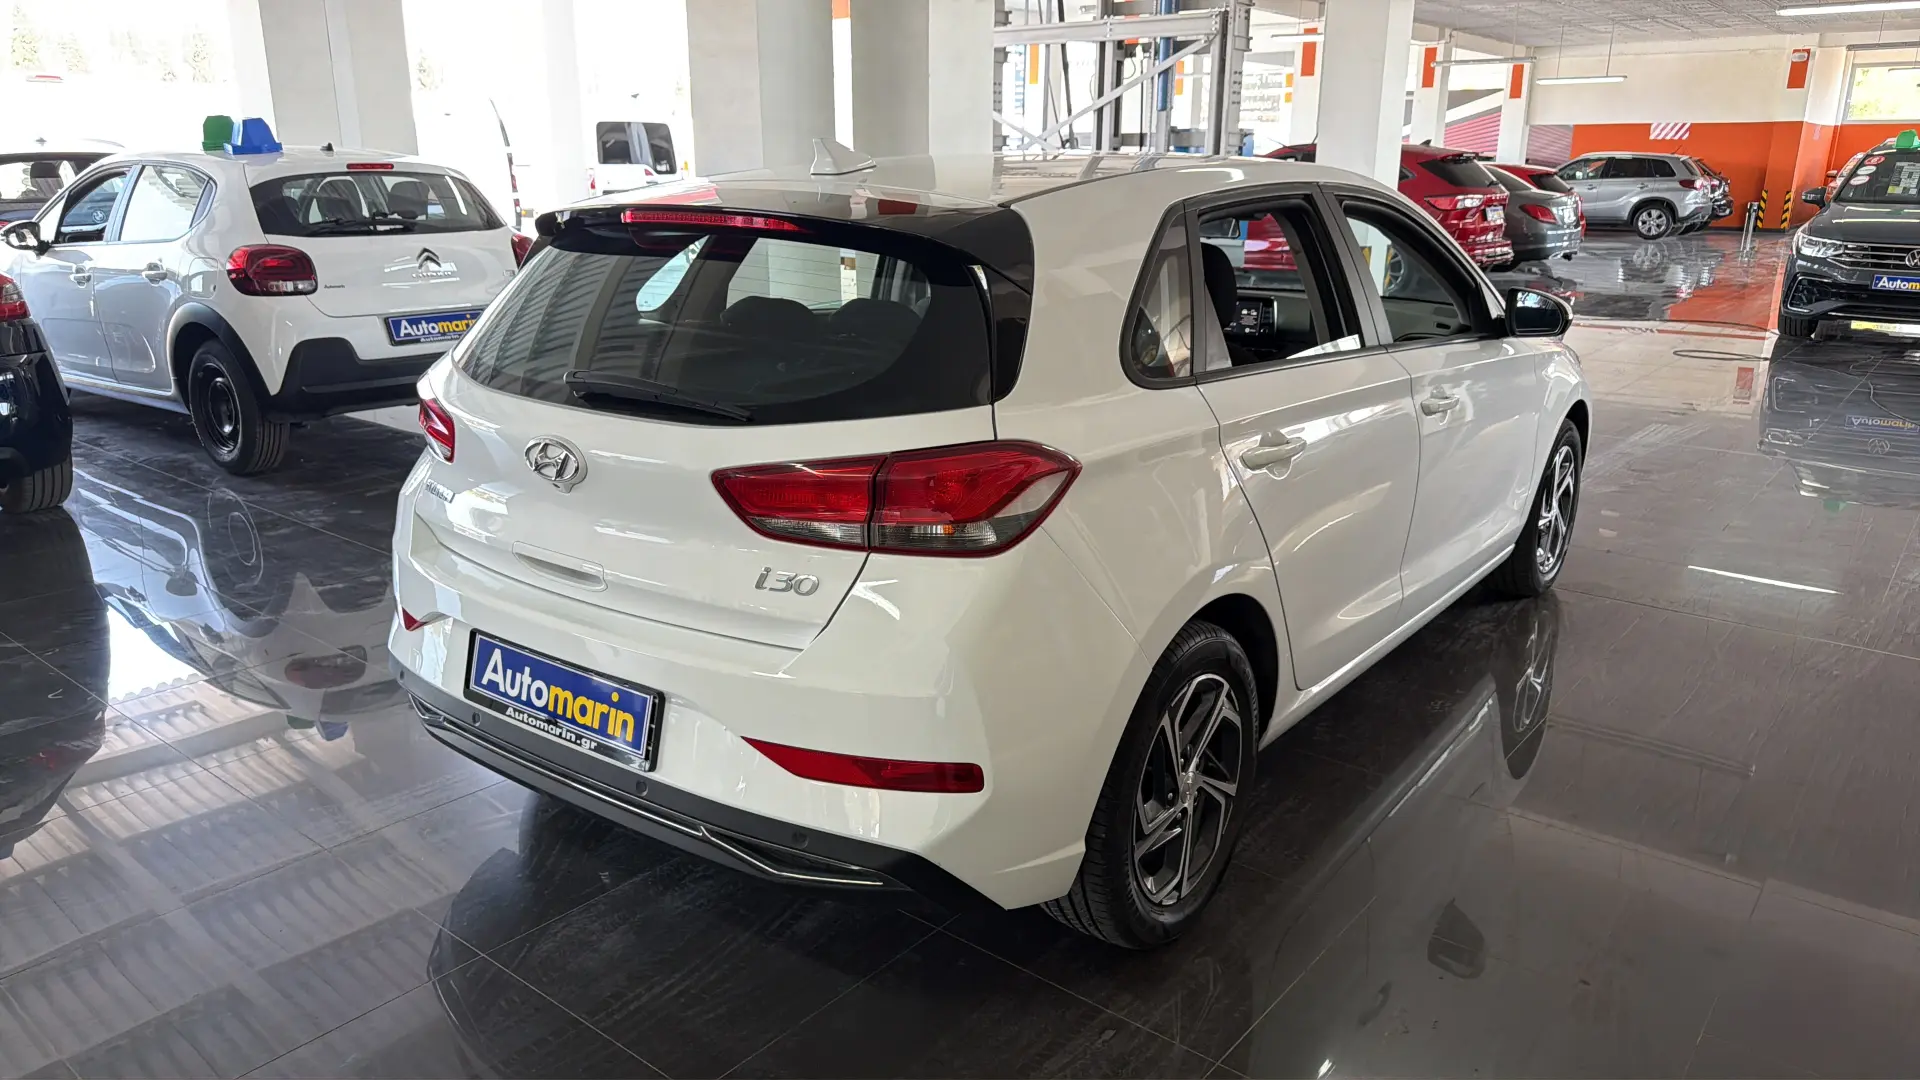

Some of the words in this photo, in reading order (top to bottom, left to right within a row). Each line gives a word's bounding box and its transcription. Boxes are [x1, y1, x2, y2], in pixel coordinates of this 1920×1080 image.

[1877, 276, 1920, 290] Autom
[400, 313, 477, 337] Automari
[755, 566, 820, 597] i30
[481, 648, 635, 742] Automarin
[505, 707, 598, 750] Automarin.gr
